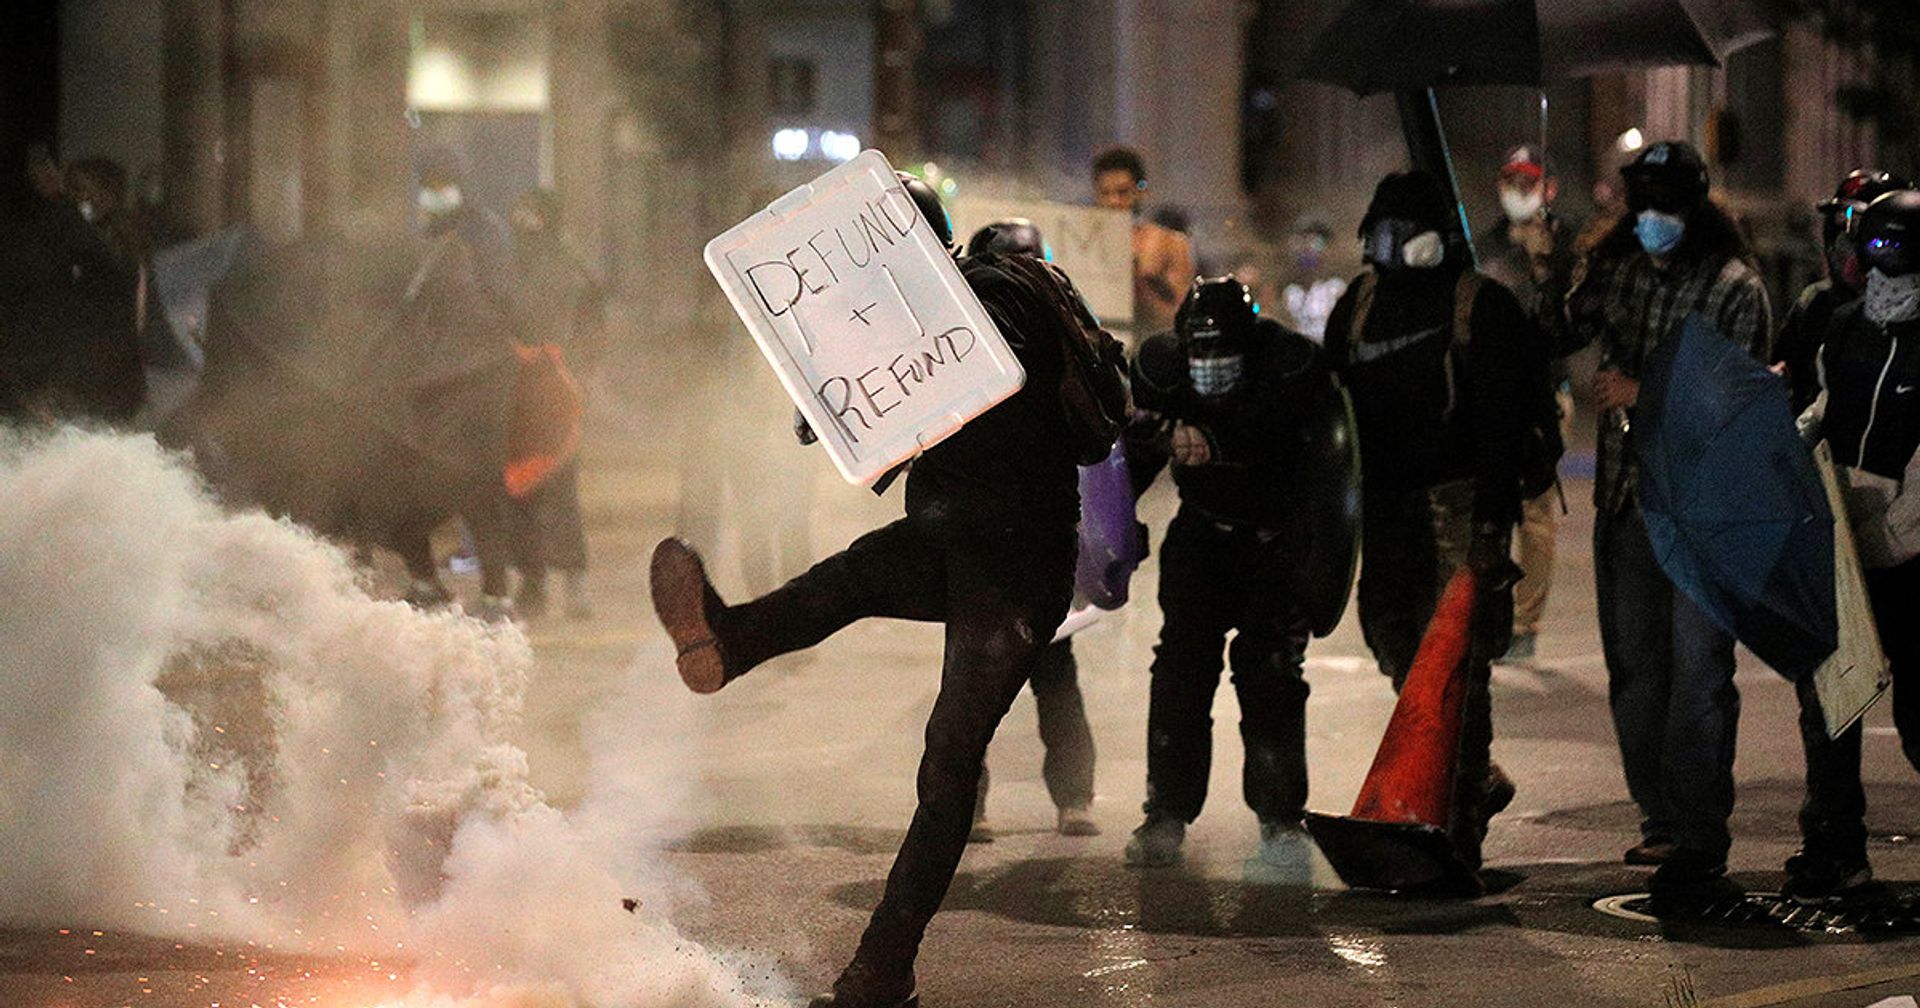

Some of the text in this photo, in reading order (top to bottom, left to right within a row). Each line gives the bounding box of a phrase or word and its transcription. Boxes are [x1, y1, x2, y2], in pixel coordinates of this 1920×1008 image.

[745, 187, 917, 316] DEFUND
[849, 302, 877, 326] +
[817, 326, 976, 443] REFUND
